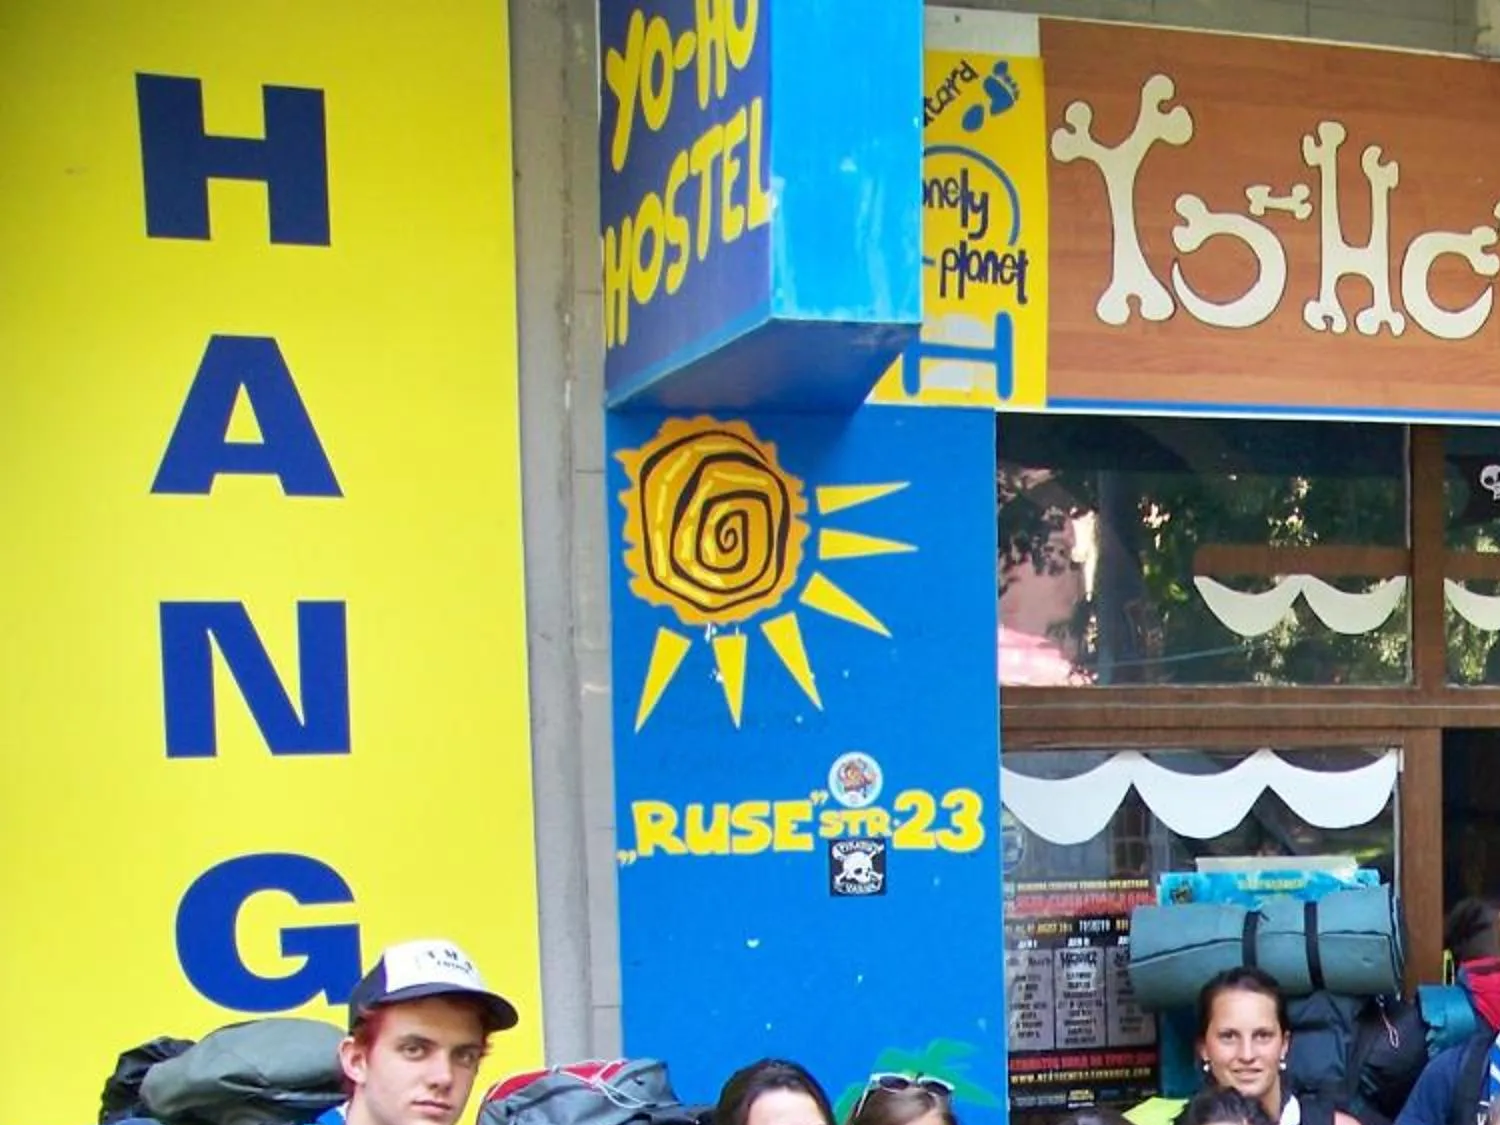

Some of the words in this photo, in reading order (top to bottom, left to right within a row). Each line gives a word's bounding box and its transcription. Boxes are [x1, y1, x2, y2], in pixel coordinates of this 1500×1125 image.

[603, 97, 772, 349] HOSTEL
[939, 239, 1029, 306] planet
[892, 787, 986, 853] 23
